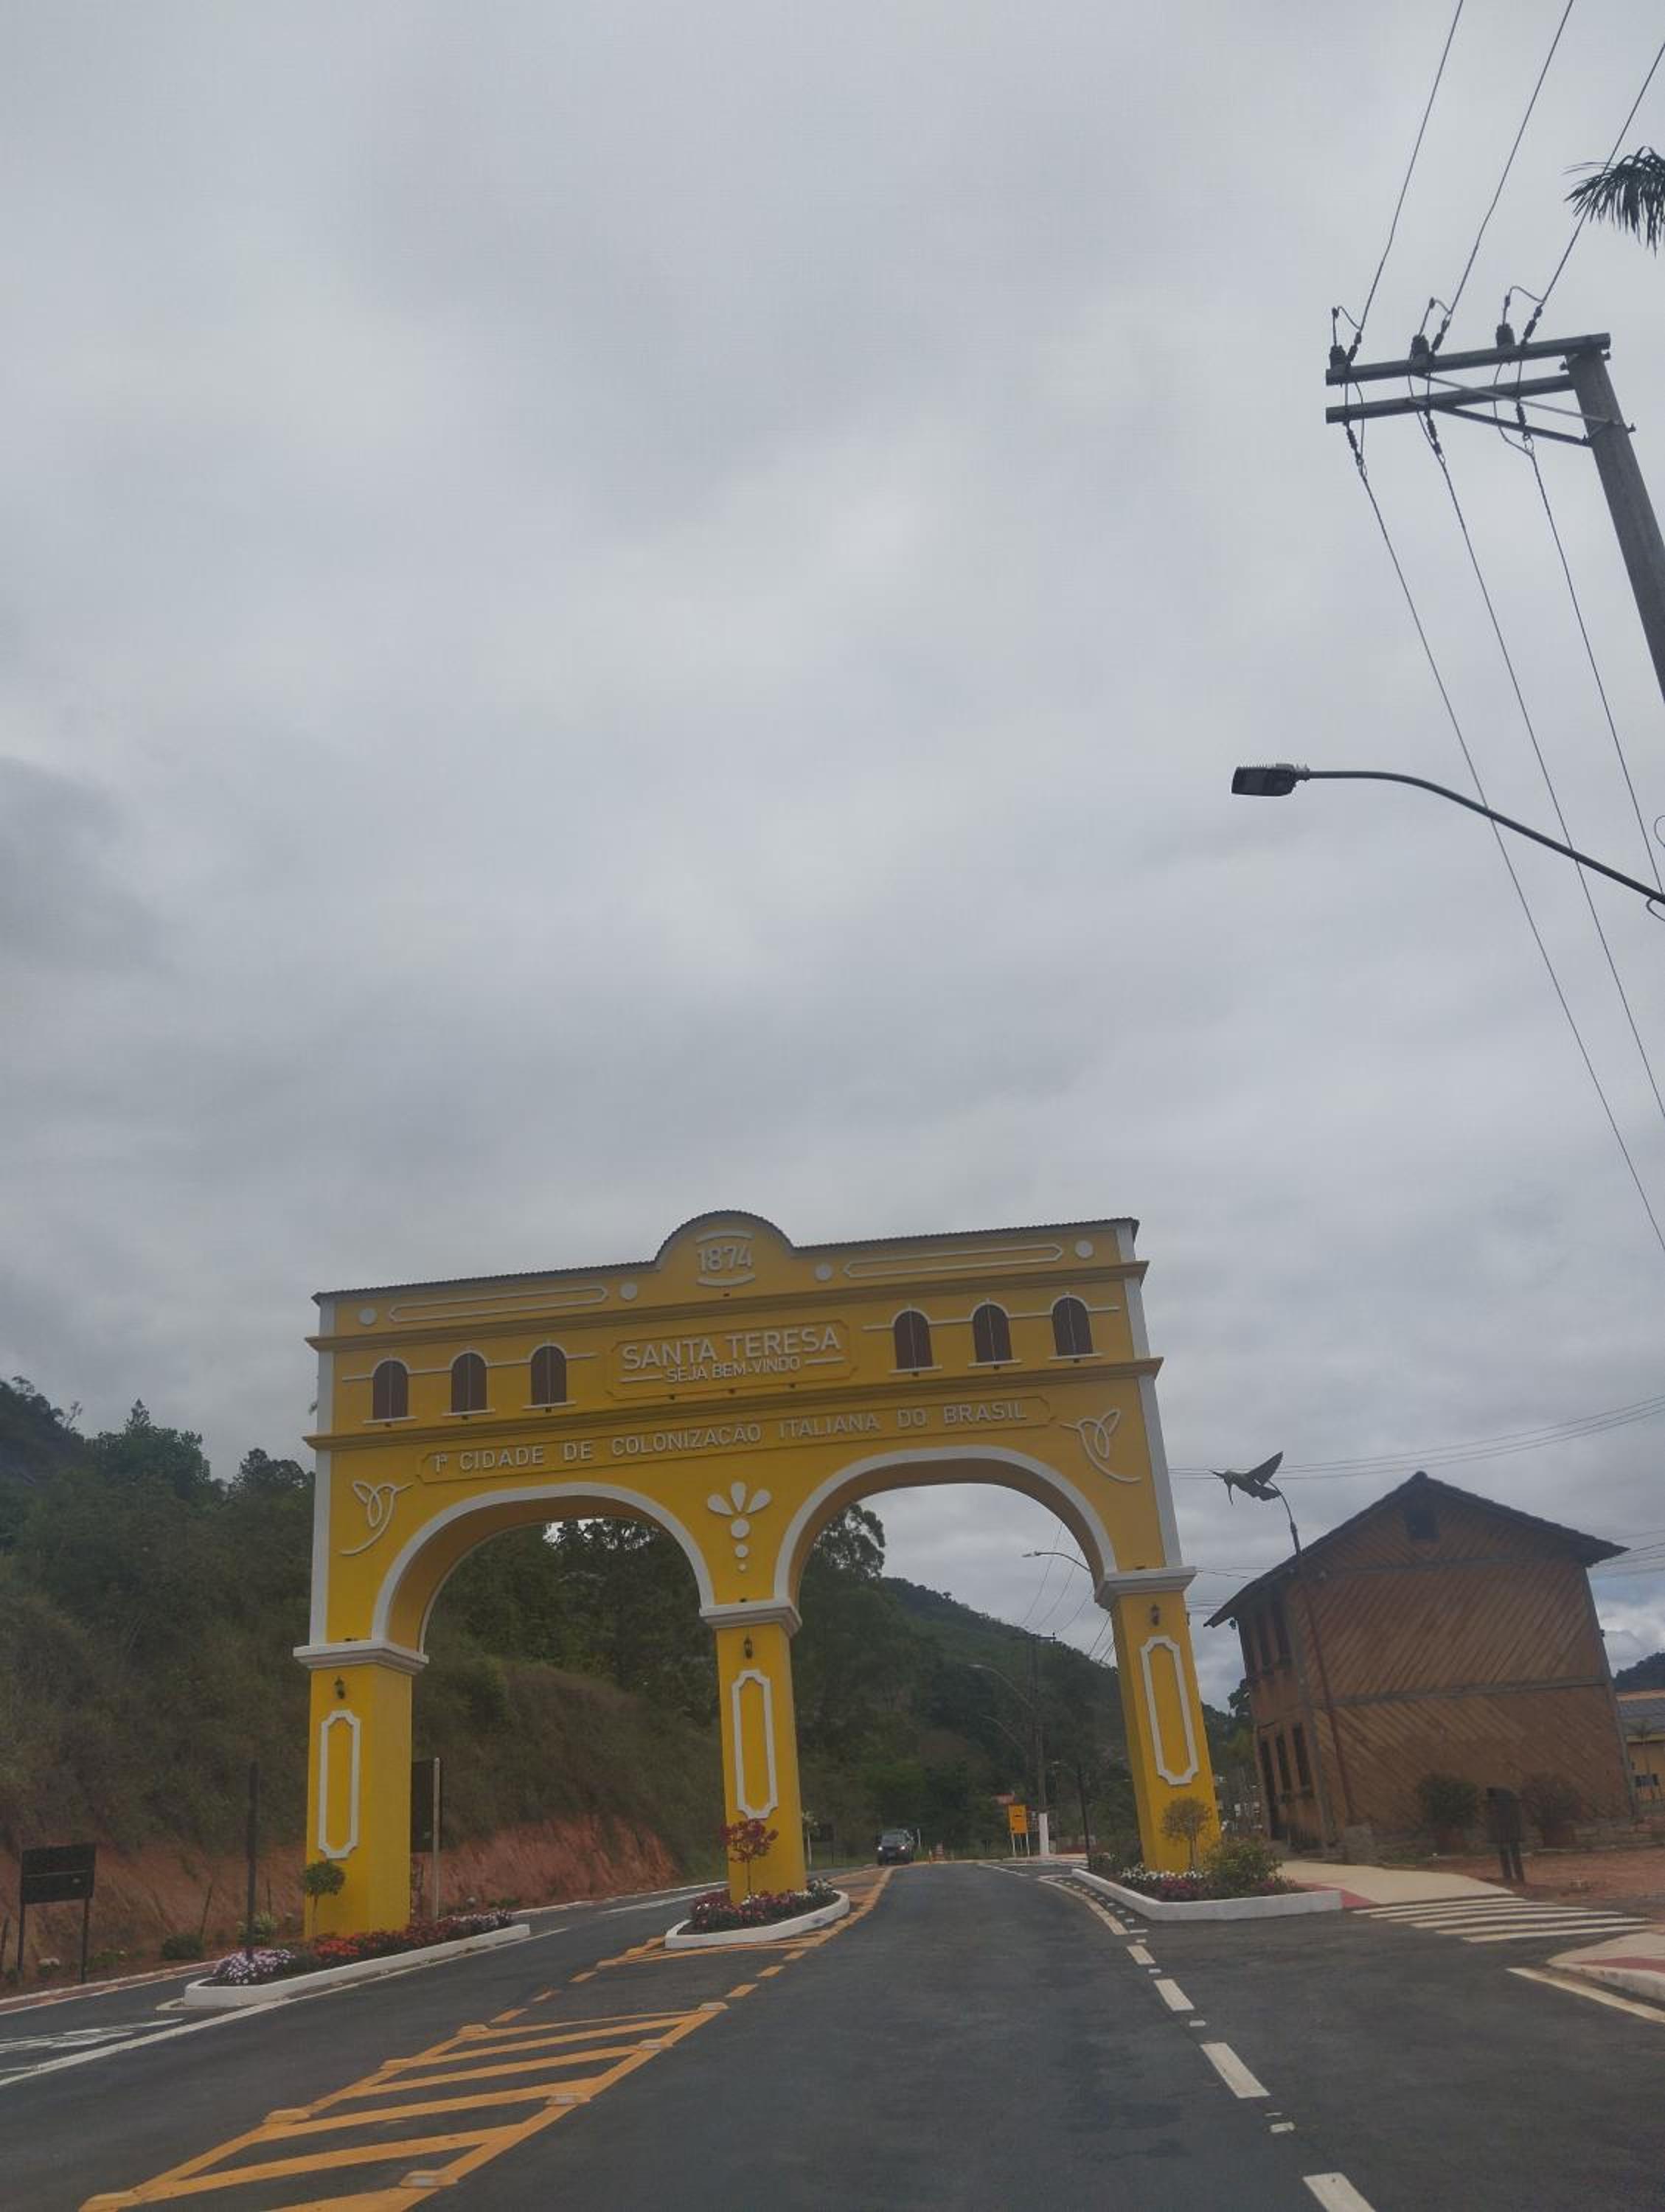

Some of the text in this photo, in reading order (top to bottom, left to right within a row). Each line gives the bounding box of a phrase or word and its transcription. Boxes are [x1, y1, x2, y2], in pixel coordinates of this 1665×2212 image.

[697, 1247, 752, 1271] 1874
[623, 1327, 841, 1369] SANTA TERESA
[666, 1355, 801, 1382] SEJA BEM-VINDO
[459, 1446, 543, 1470] CIDADE
[563, 1441, 593, 1461] DE
[779, 1413, 880, 1439] ITALIANA
[897, 1408, 926, 1428] DO
[944, 1402, 1027, 1425] BRASIL
